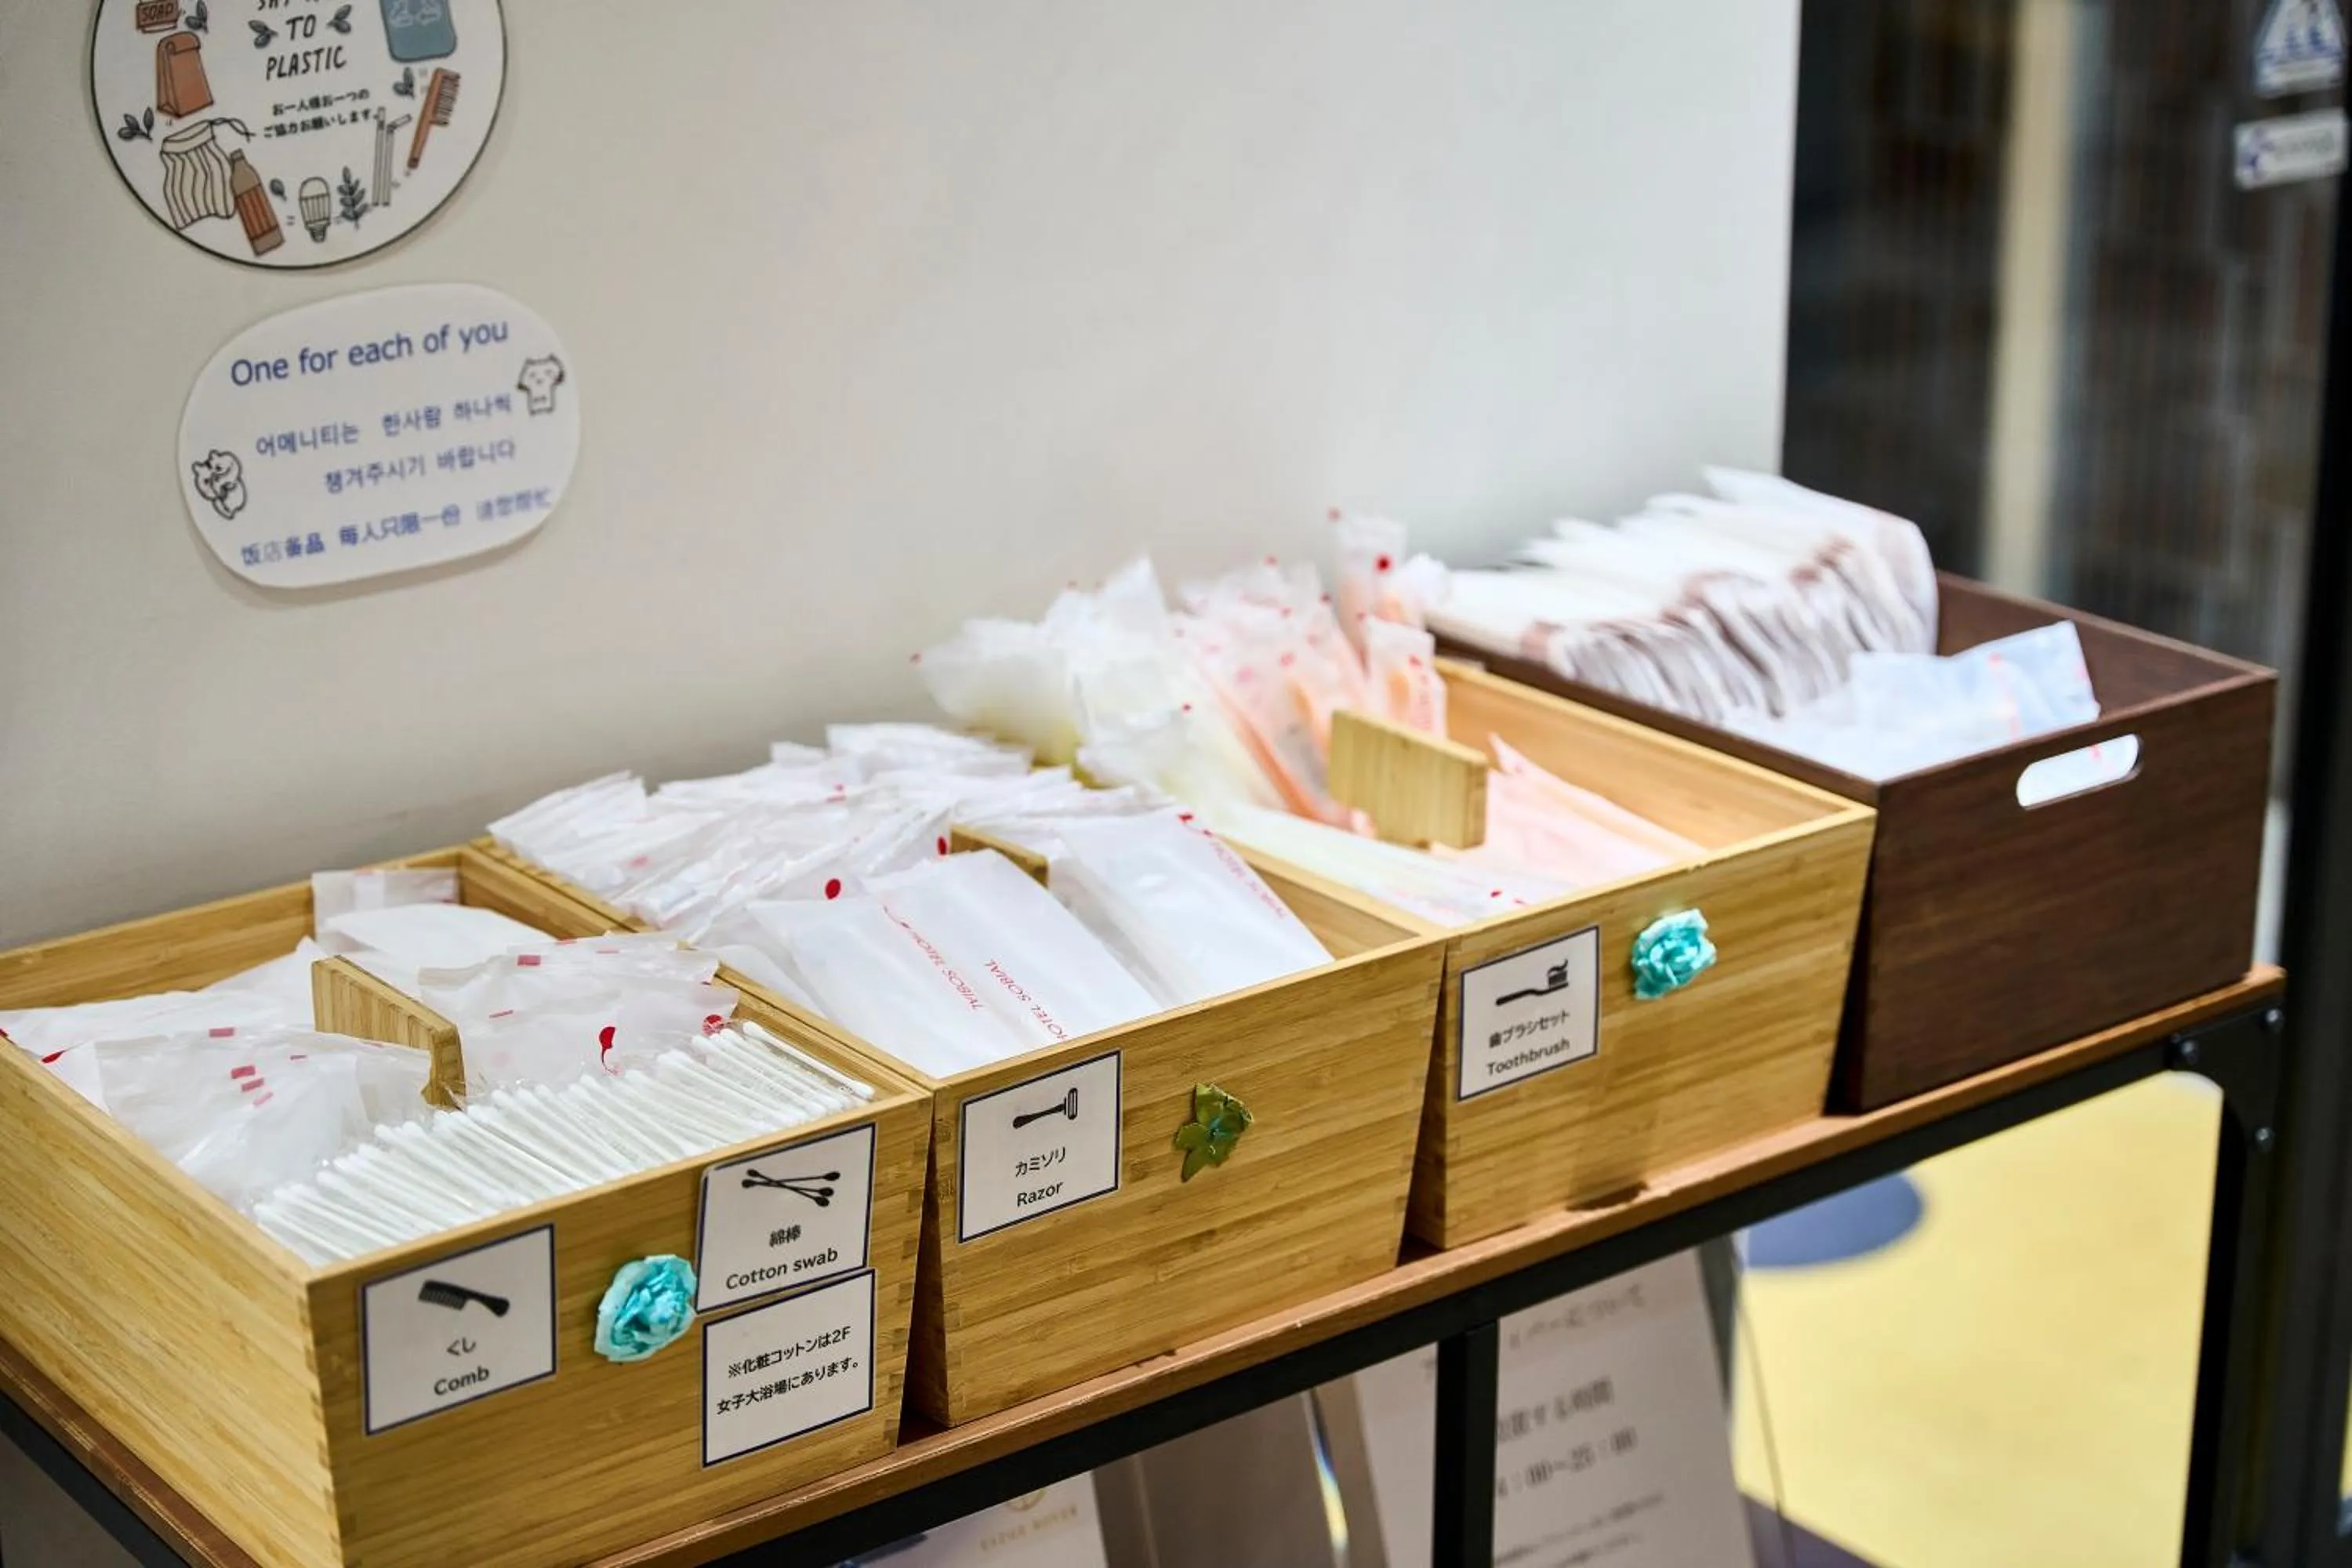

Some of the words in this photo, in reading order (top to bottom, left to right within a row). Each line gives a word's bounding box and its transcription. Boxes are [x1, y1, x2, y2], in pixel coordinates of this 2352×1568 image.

[286, 14, 316, 40] TO
[266, 45, 347, 81] PLASTIC
[230, 359, 289, 387] One
[299, 347, 338, 375] for
[347, 332, 413, 366] each
[422, 323, 451, 353] of
[459, 321, 507, 353] you
[256, 423, 359, 457] 어메니티는
[383, 406, 441, 437] 한사람
[1489, 1009, 1571, 1048] 歯ブラシセット
[1487, 1037, 1571, 1076] Toothbrush
[1015, 1146, 1065, 1178] カミソリ
[1017, 1181, 1064, 1207] Razor
[768, 1224, 801, 1247] 綿棒
[726, 1263, 788, 1290] Cotton
[793, 1247, 838, 1272] swab
[446, 1337, 477, 1357] くし
[434, 1365, 490, 1396] Comb
[717, 1357, 859, 1414] 女子大浴場にあります。
